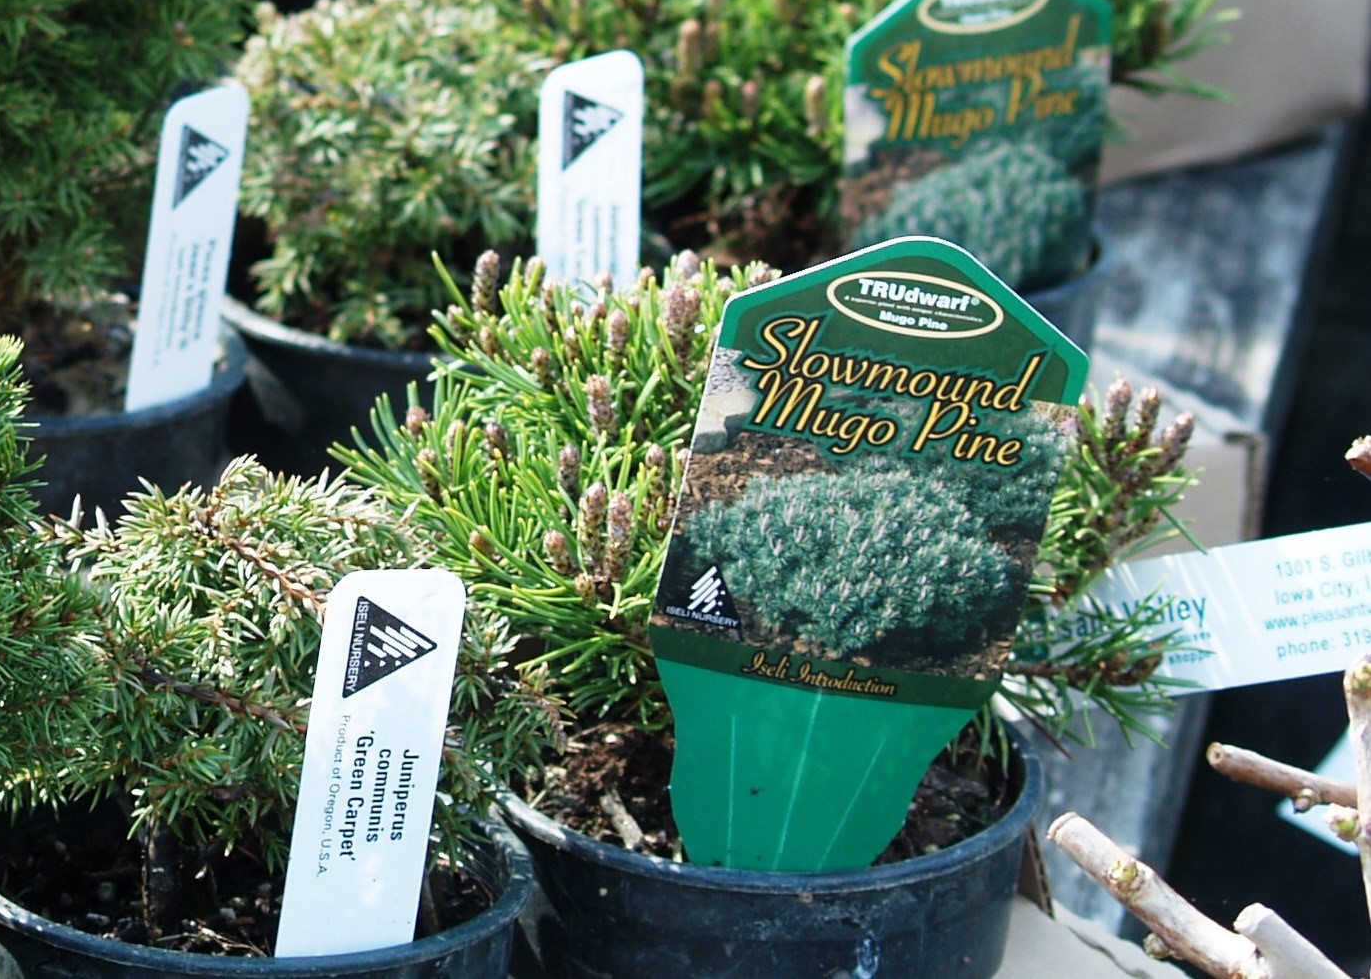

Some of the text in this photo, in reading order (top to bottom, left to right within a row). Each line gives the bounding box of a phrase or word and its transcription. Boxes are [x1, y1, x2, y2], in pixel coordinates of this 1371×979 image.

[879, 311, 949, 331] Mugo Pine
[744, 318, 1042, 412] Slowmound
[753, 370, 1022, 465] Mugo Pine
[1276, 559, 1312, 578] 1301
[665, 605, 739, 627] ISELI NURSERY
[1275, 587, 1314, 604] Iowa
[345, 601, 370, 693] ISELI NURSERY
[742, 651, 897, 696] Iseli Introduction
[333, 714, 351, 764] Product
[331, 767, 341, 780] of
[365, 748, 392, 843] communis
[390, 749, 419, 841] Juniperus
